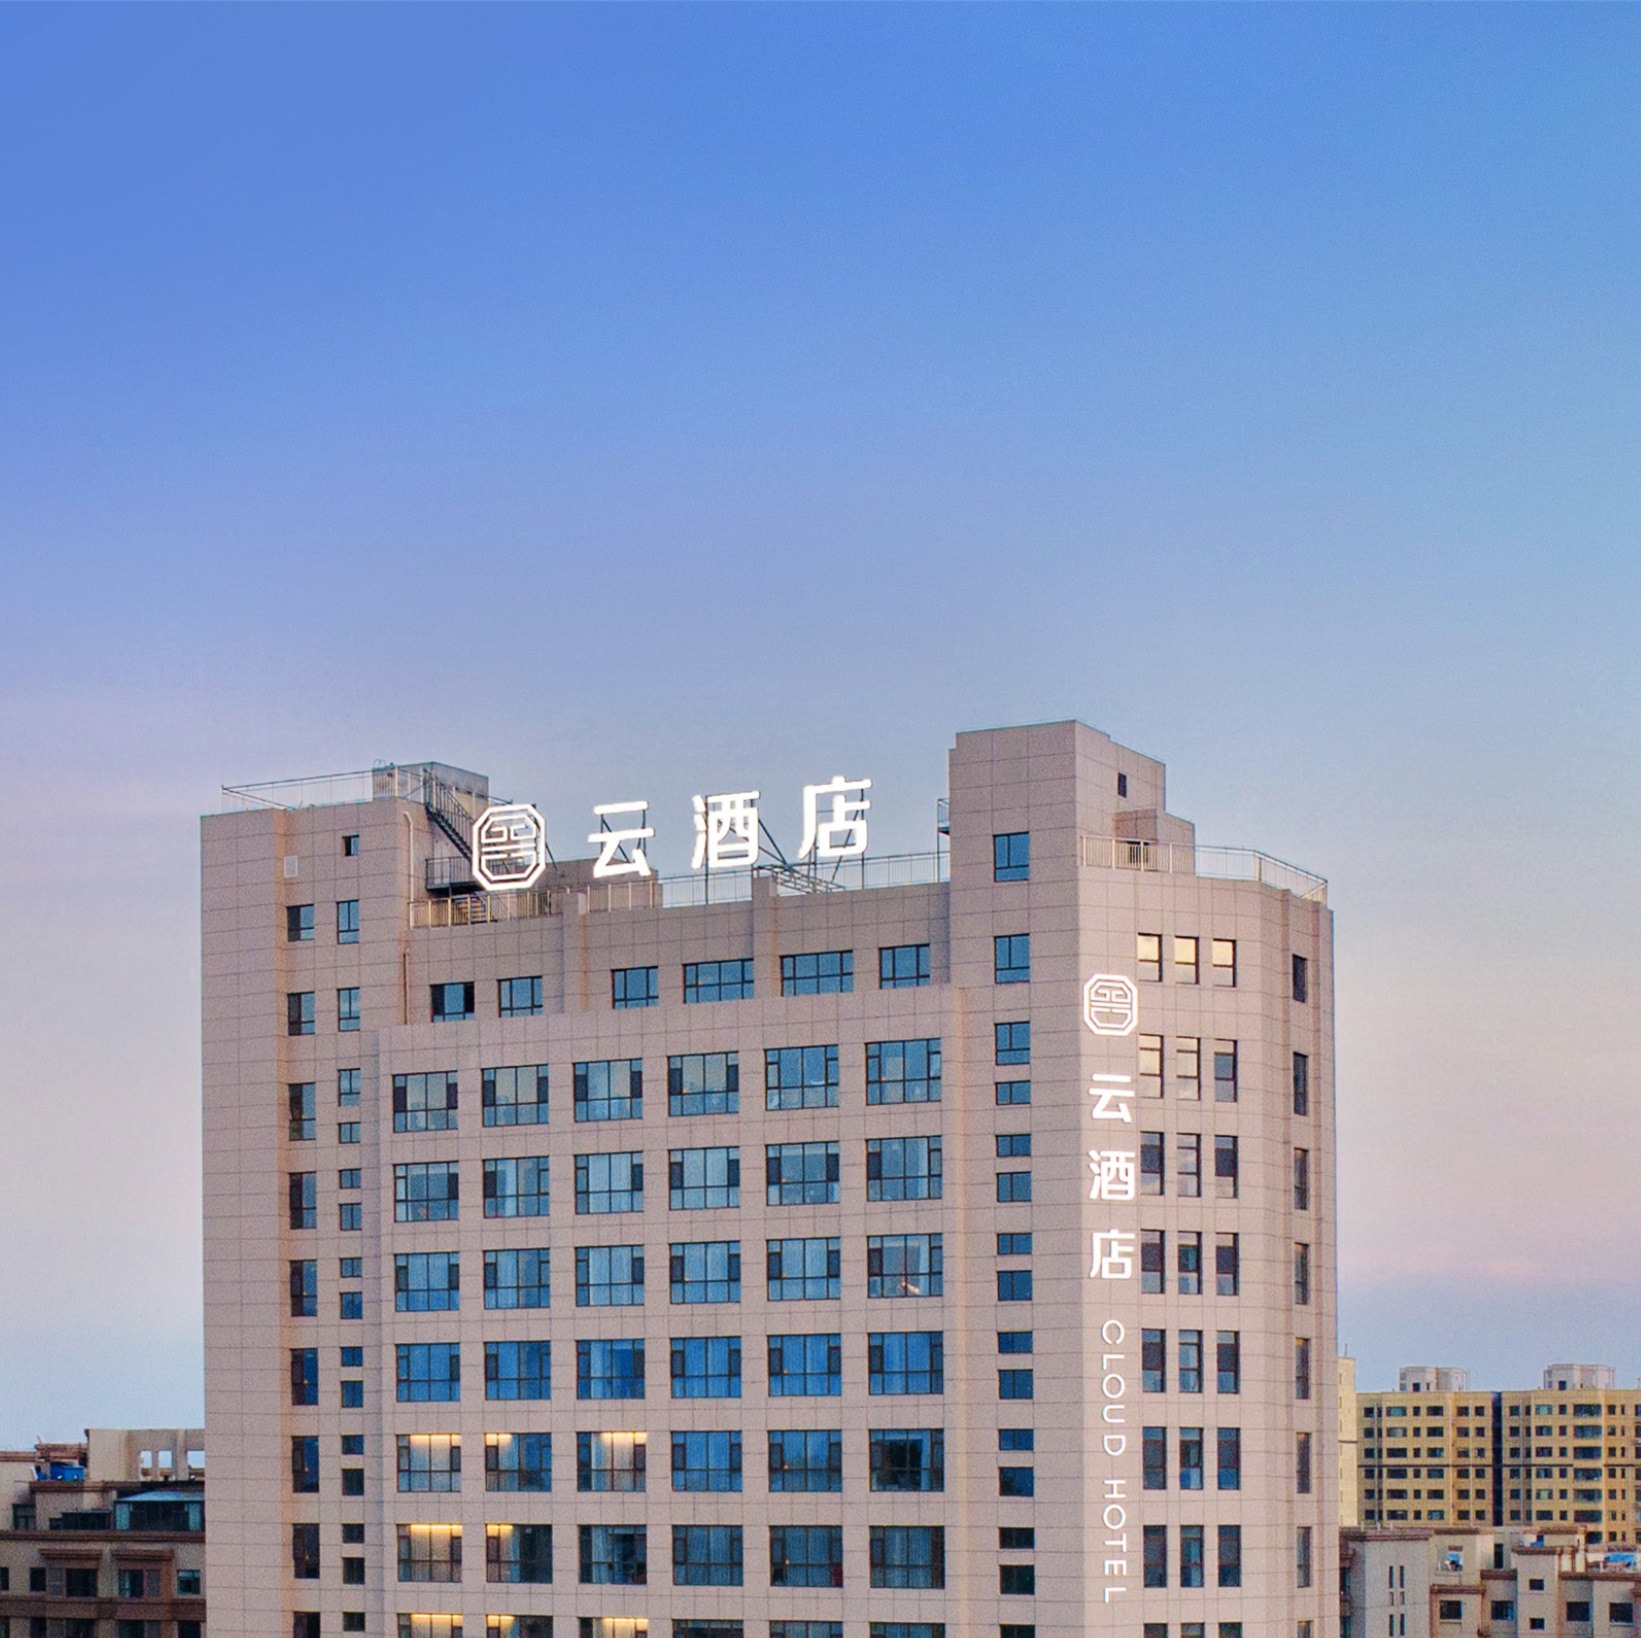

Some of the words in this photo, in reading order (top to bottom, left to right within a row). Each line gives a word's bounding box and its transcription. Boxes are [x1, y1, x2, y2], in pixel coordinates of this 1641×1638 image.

[587, 775, 872, 878] 云酒店
[1088, 1074, 1136, 1279] 云酒店
[1101, 1319, 1127, 1456] CLOUD
[1102, 1479, 1128, 1604] HOTEL
